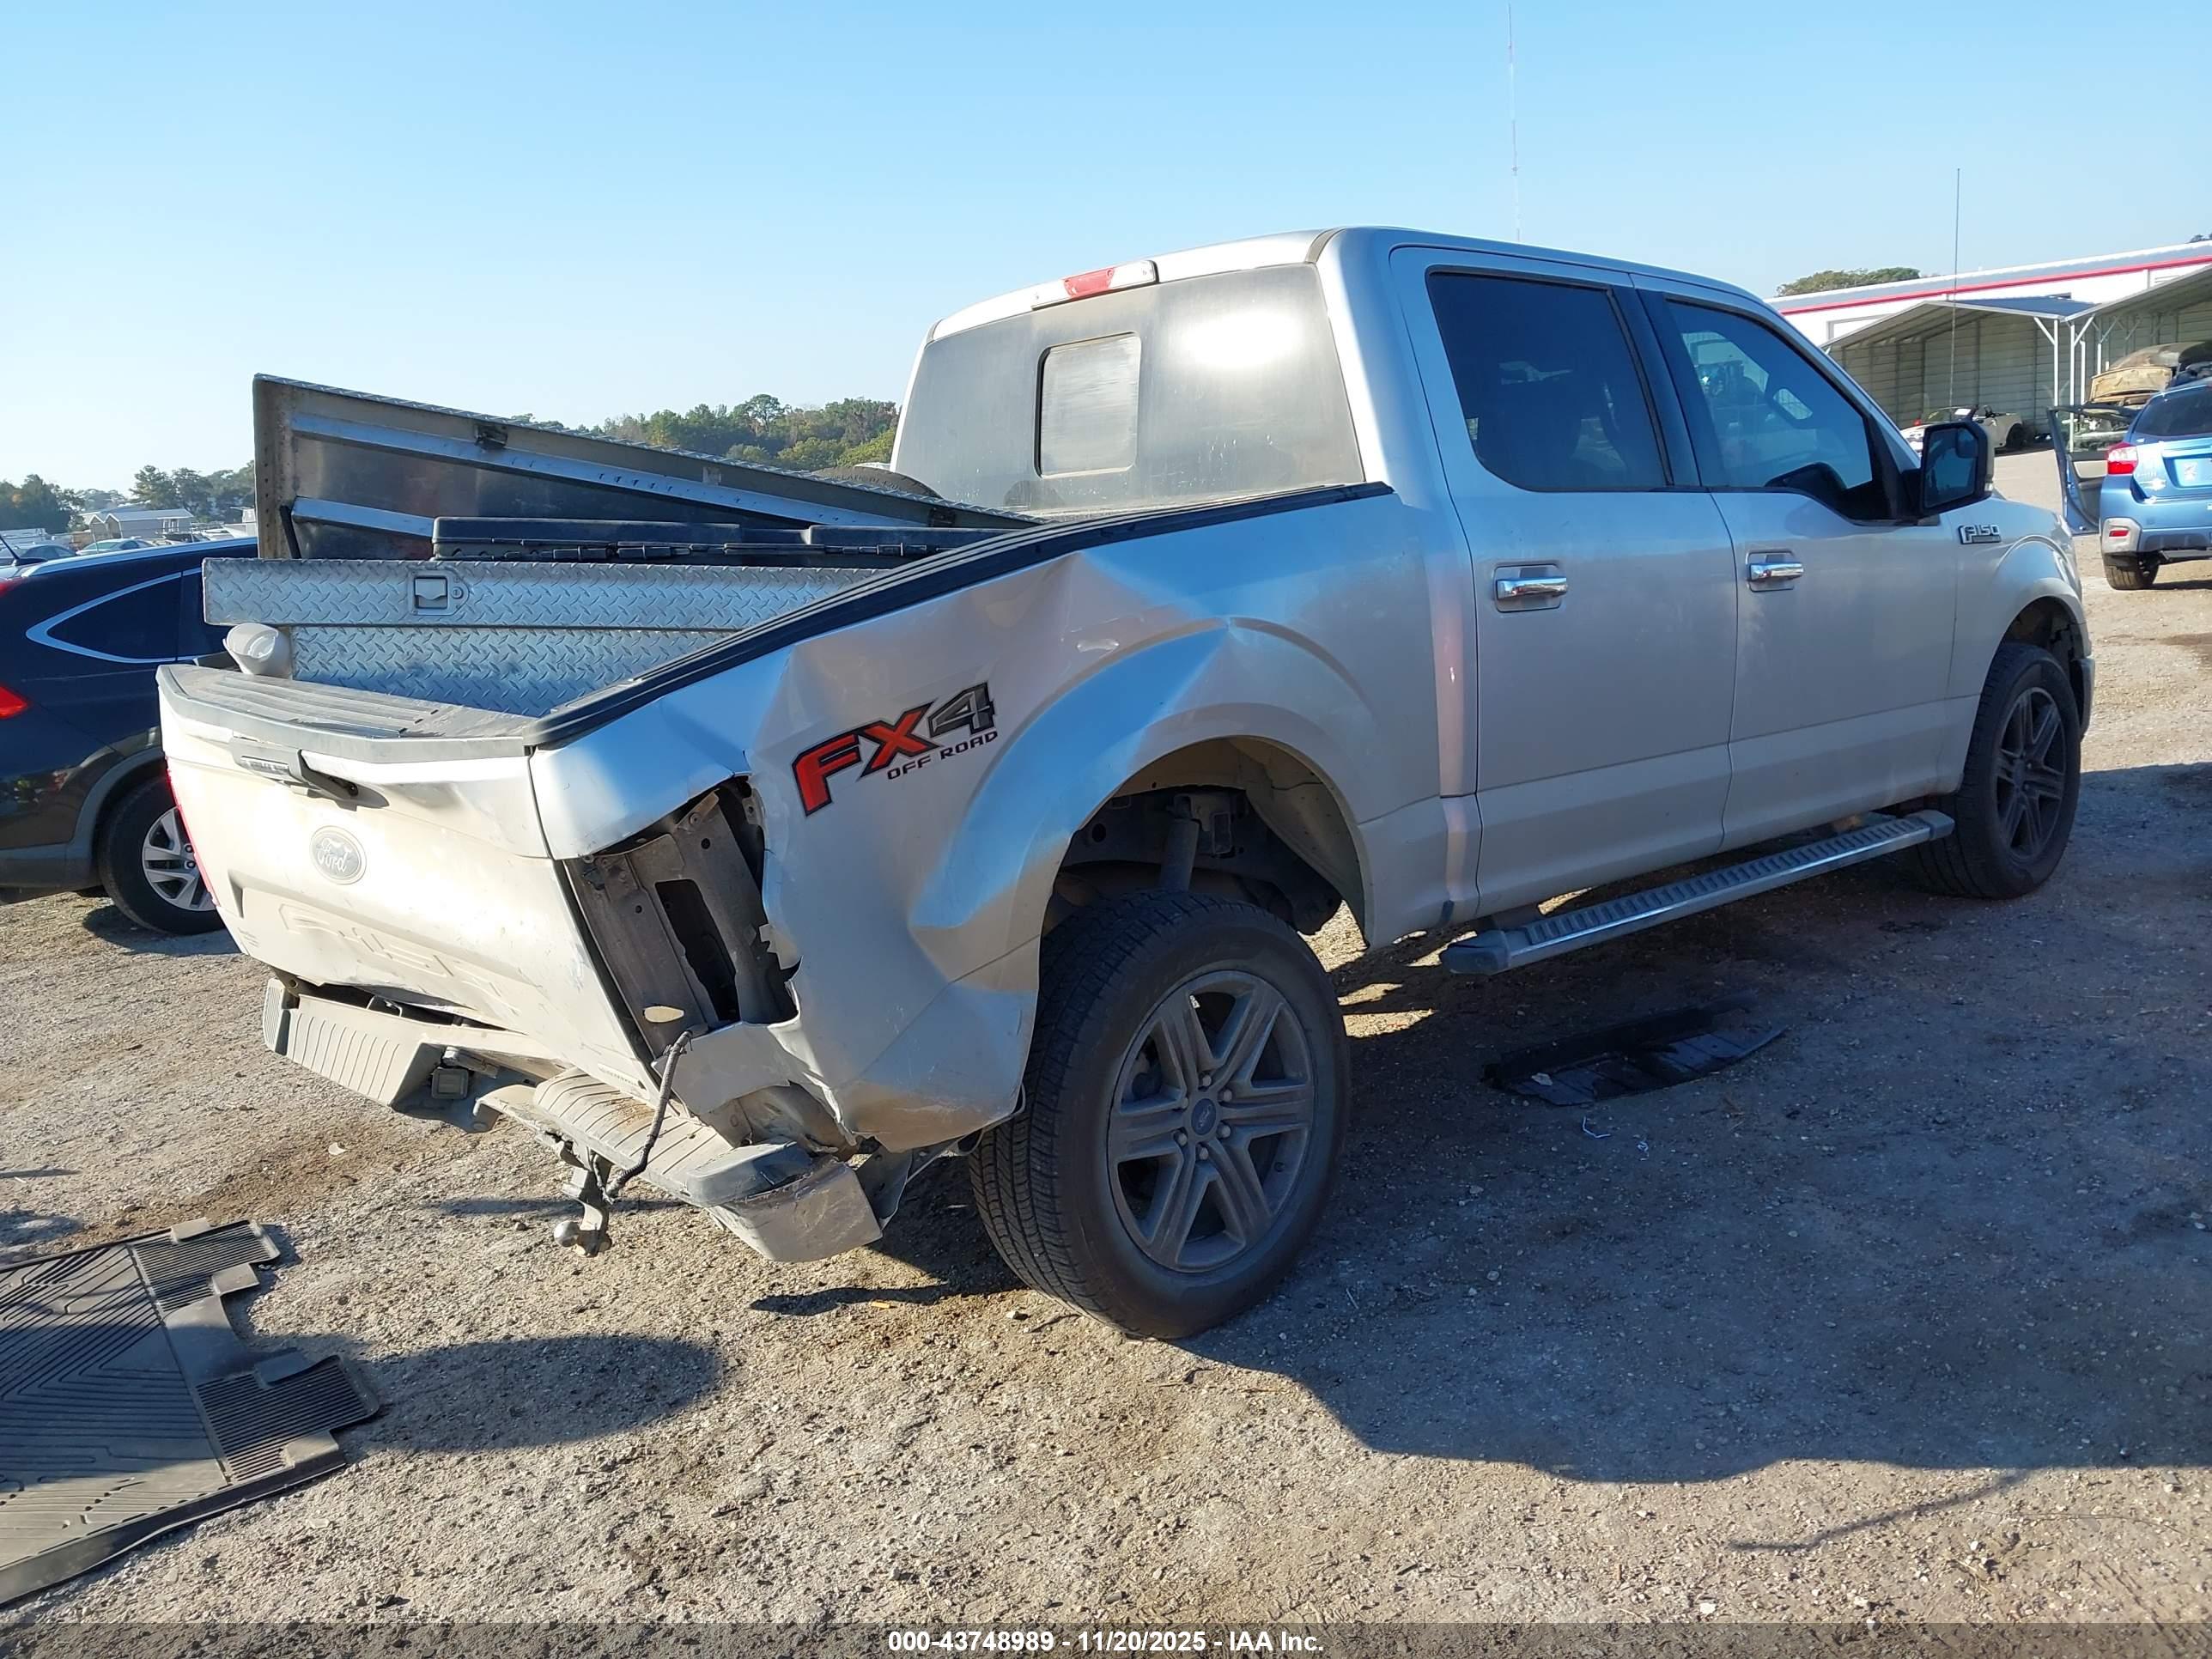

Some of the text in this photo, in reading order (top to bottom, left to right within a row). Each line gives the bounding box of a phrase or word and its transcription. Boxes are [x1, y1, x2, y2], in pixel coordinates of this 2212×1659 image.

[792, 681, 996, 817] FX4
[887, 730, 999, 780] OFF ROAD
[316, 836, 351, 873] Ford
